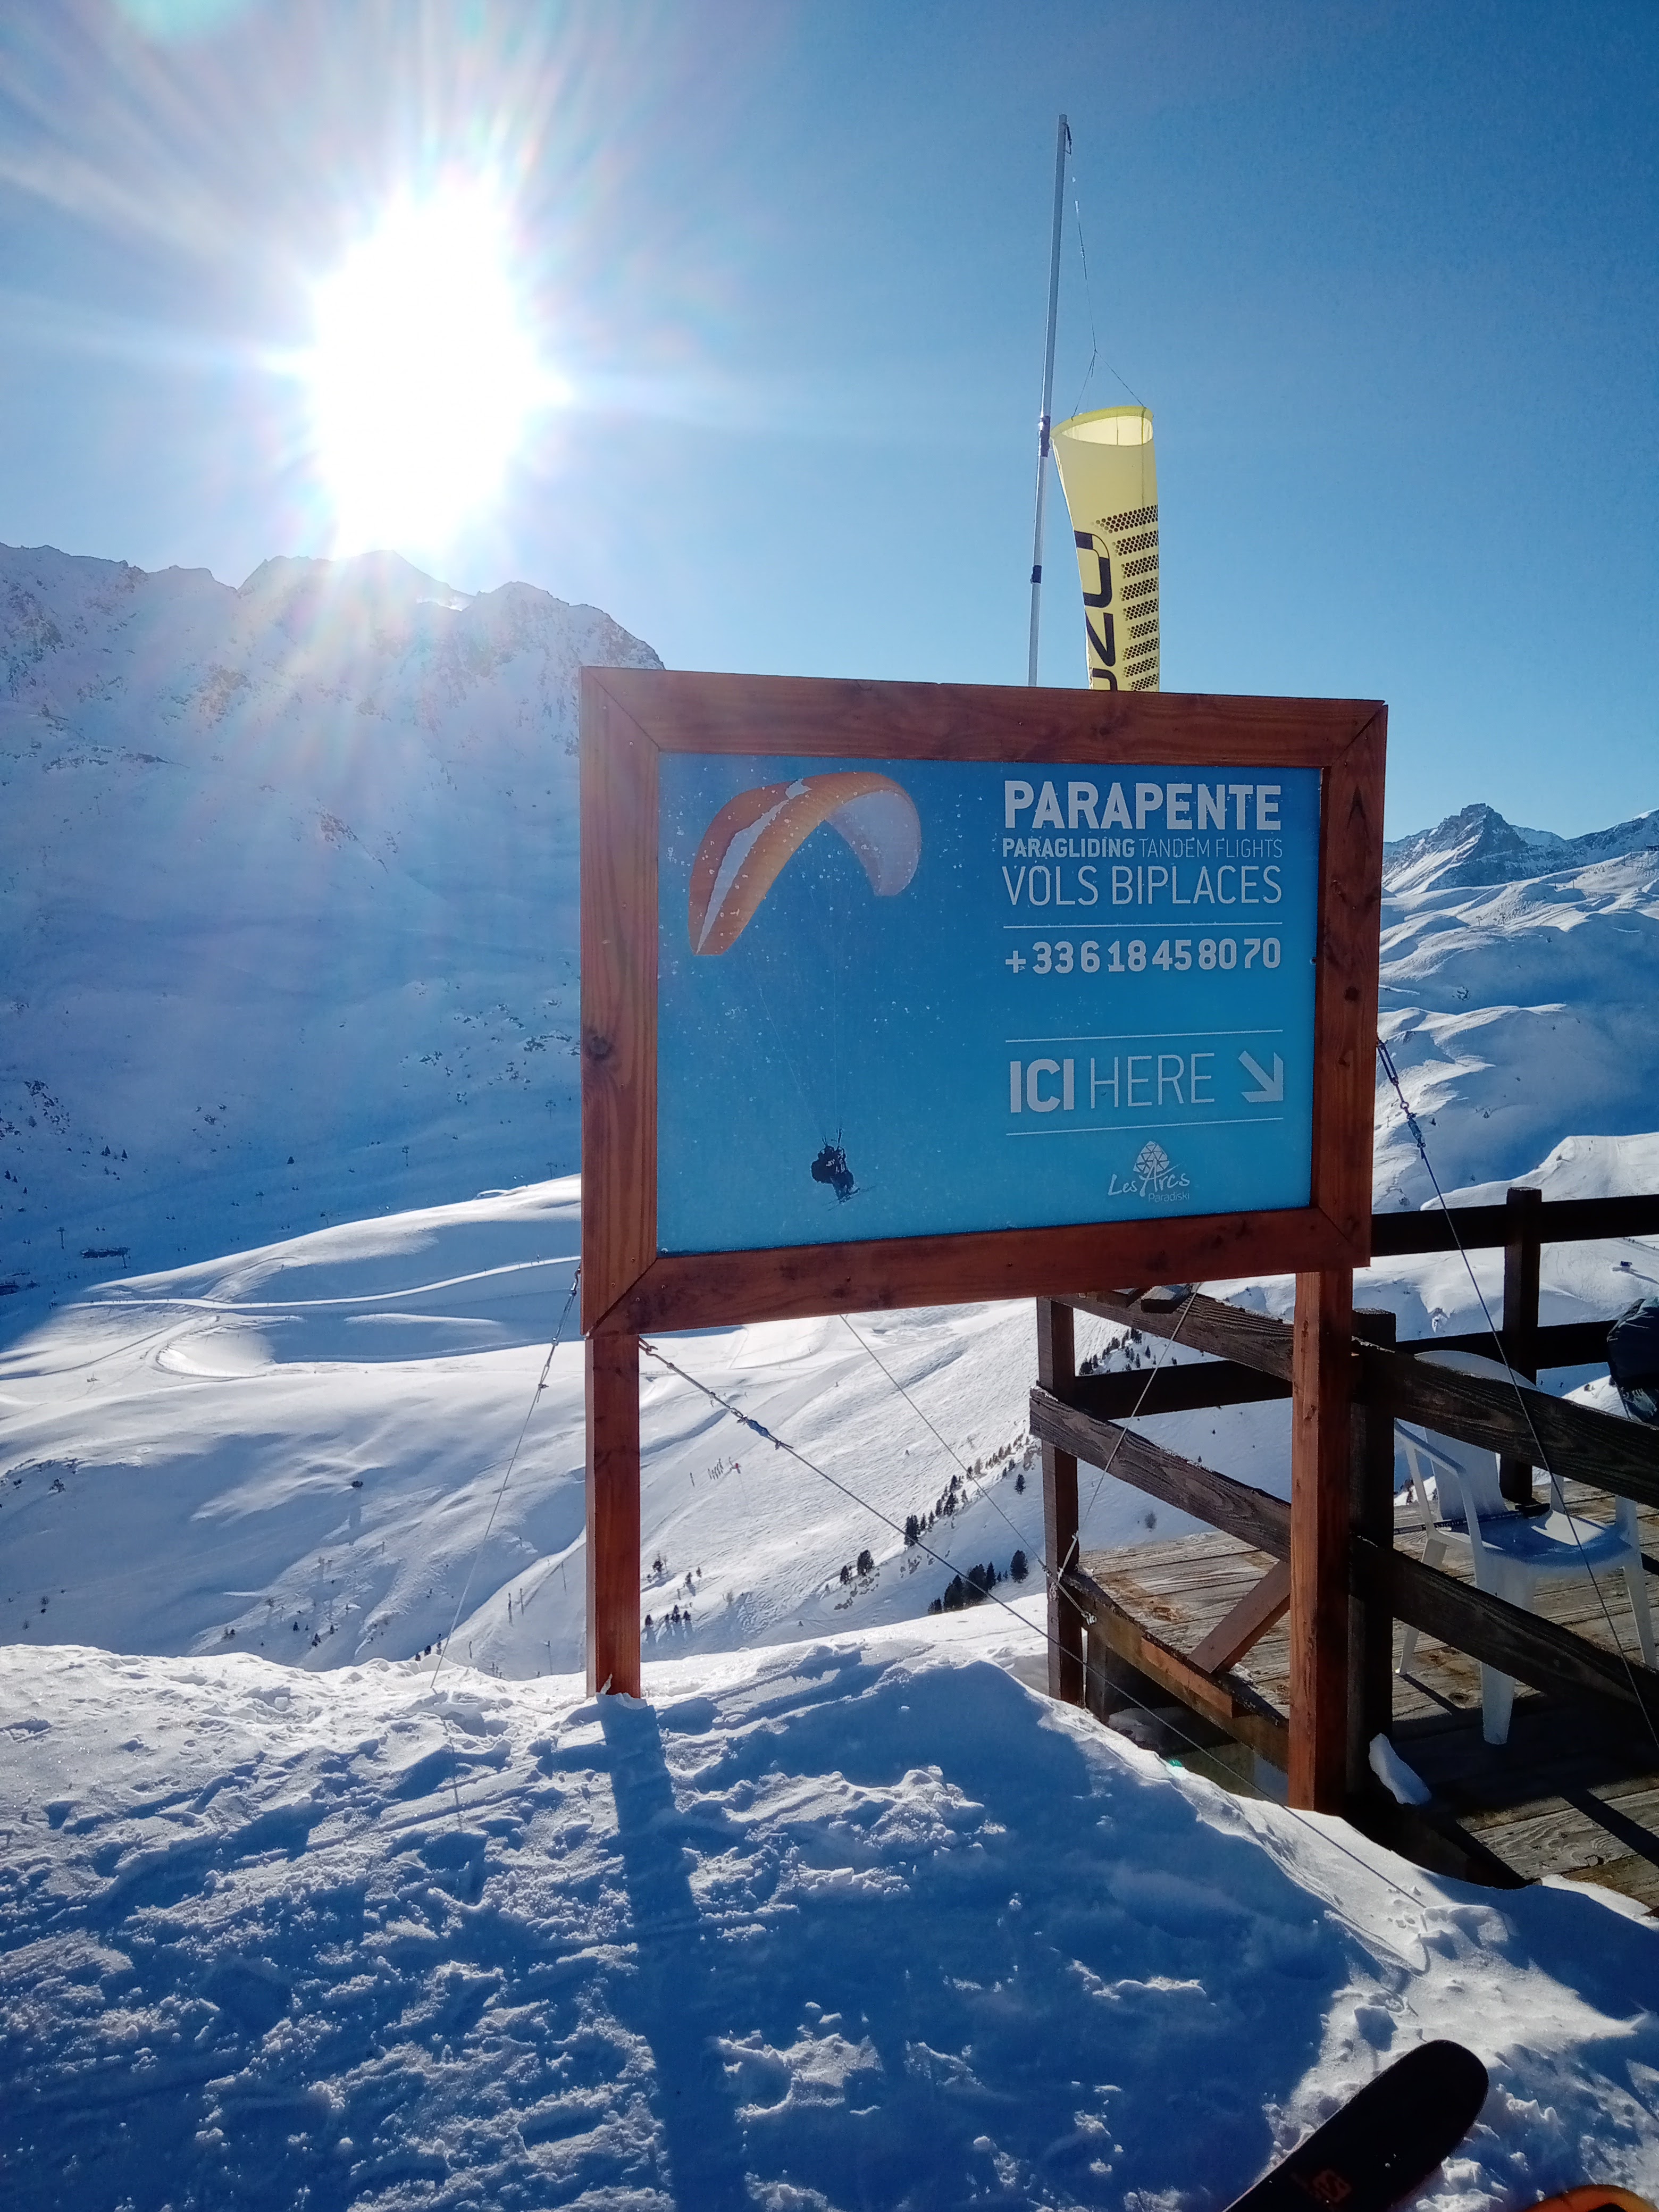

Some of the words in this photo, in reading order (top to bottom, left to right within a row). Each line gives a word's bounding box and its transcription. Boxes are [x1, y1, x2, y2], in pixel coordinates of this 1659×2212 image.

[1004, 780, 1281, 830] PARAPENTE
[1003, 837, 1135, 858] PARAGLIDING
[1139, 838, 1209, 858] TANDEM
[1216, 838, 1283, 858] FLIGHTS
[1002, 865, 1098, 906] VOLS
[1112, 865, 1281, 904] BIPLACES
[1010, 1059, 1074, 1113] ICI
[1091, 1053, 1214, 1109] HERE
[1108, 1174, 1137, 1196] Les
[1139, 1158, 1191, 1197] Arcs
[1148, 1191, 1190, 1203] Paradiski
